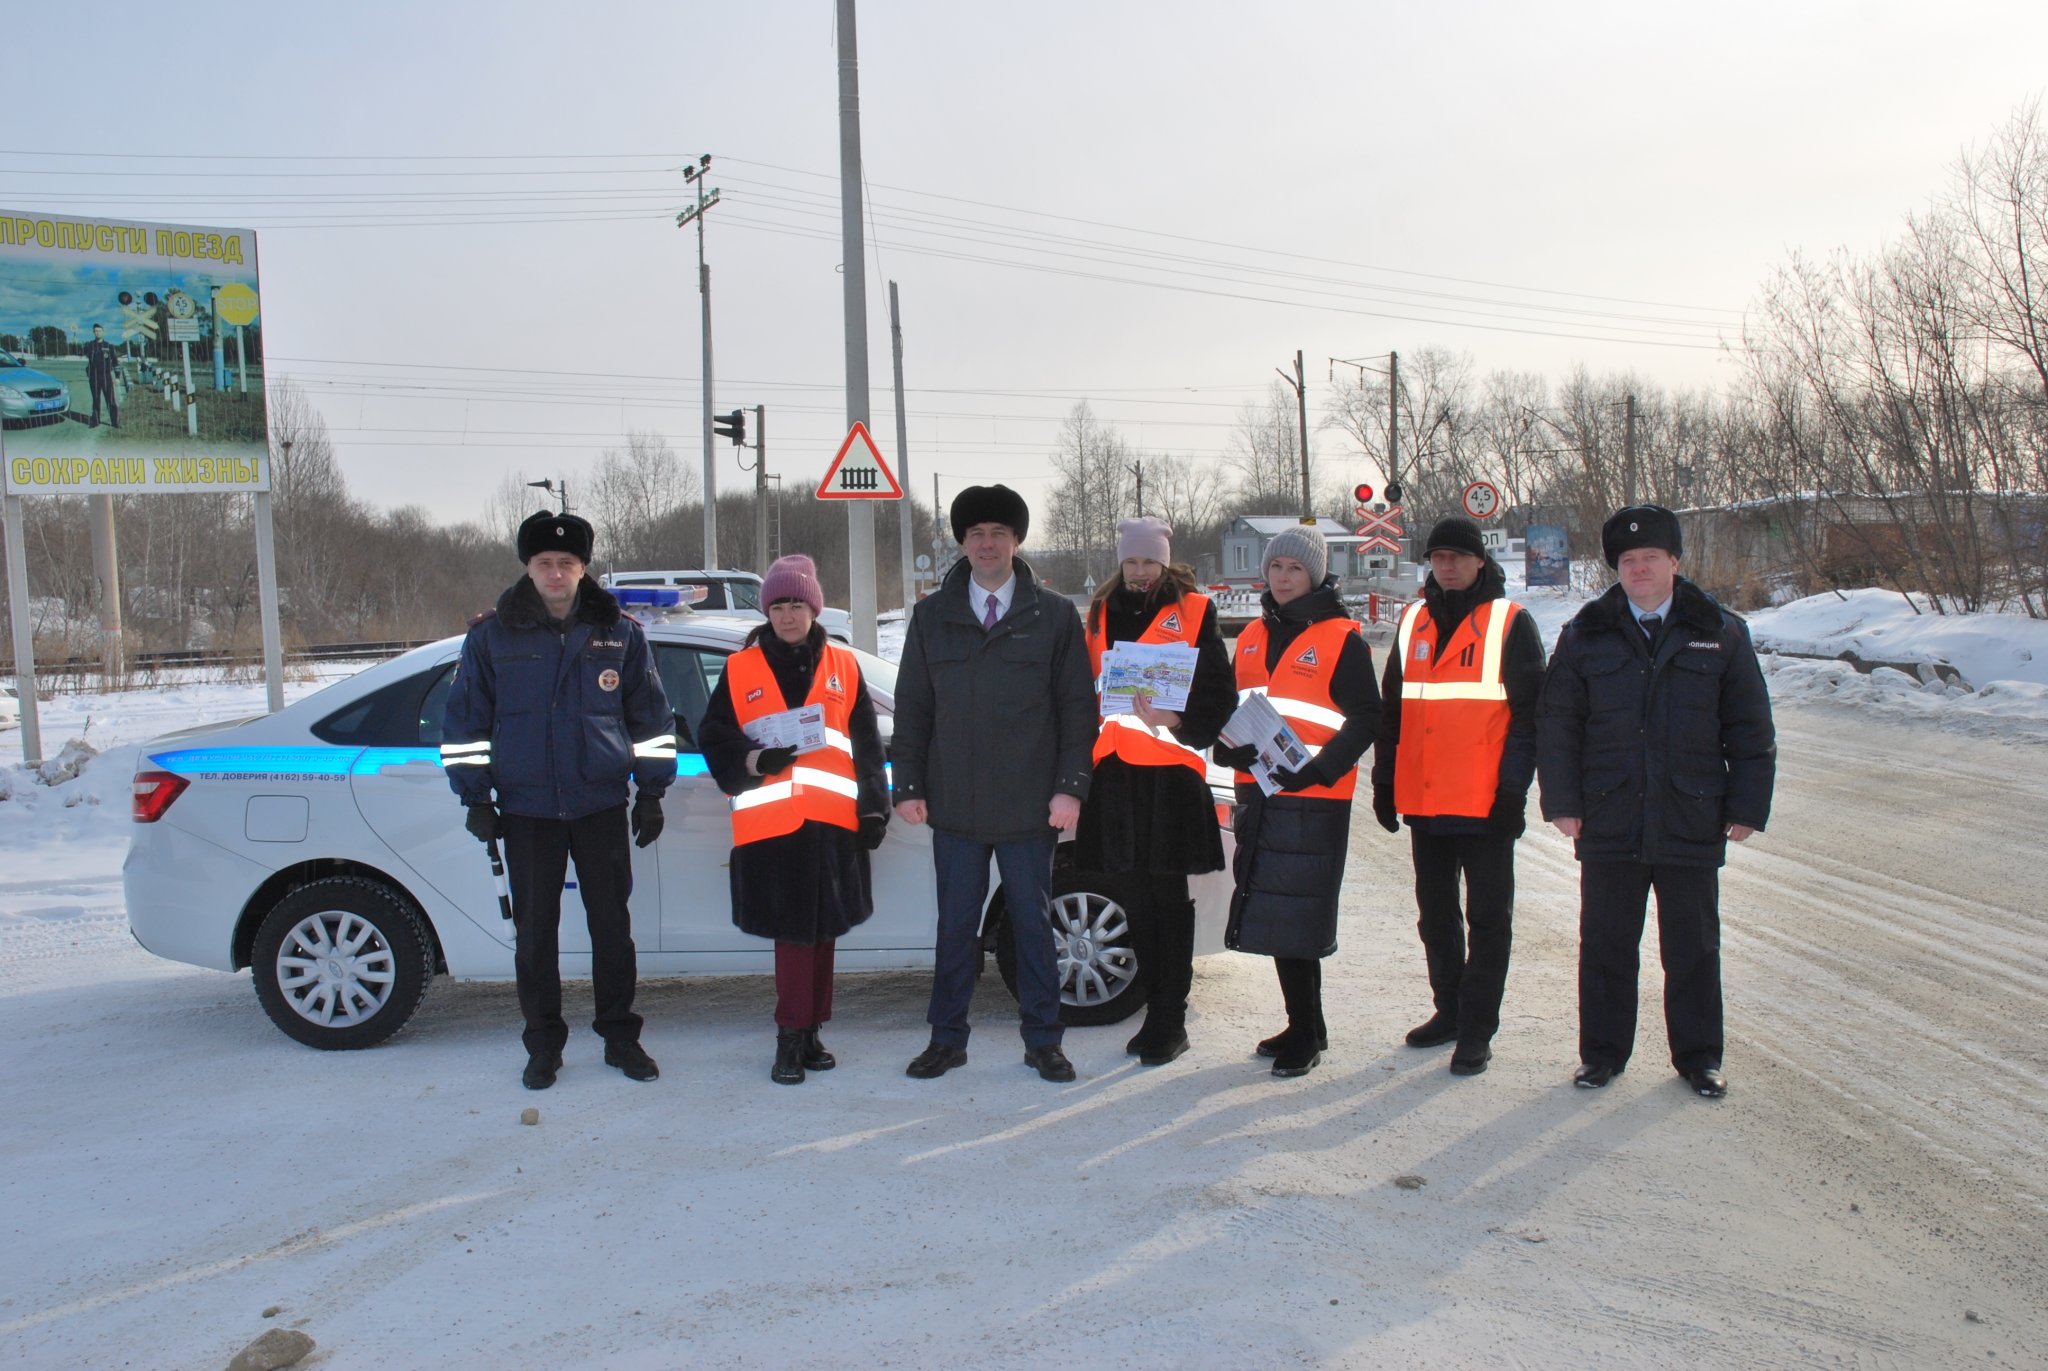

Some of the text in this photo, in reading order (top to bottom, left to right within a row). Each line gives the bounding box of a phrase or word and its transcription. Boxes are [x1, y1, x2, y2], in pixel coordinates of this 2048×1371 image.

[0, 217, 243, 265] ПРОПУСТИ ПОЕЗД
[217, 296, 258, 312] STOP
[12, 457, 259, 485] СОХРАНИ ЖИЗНЬ!
[1688, 641, 1720, 649] ОЛИЦИЯ
[222, 773, 268, 782] ДОВЕРИЯ
[270, 773, 300, 782] (4162)
[302, 774, 346, 782] 59-40-59
